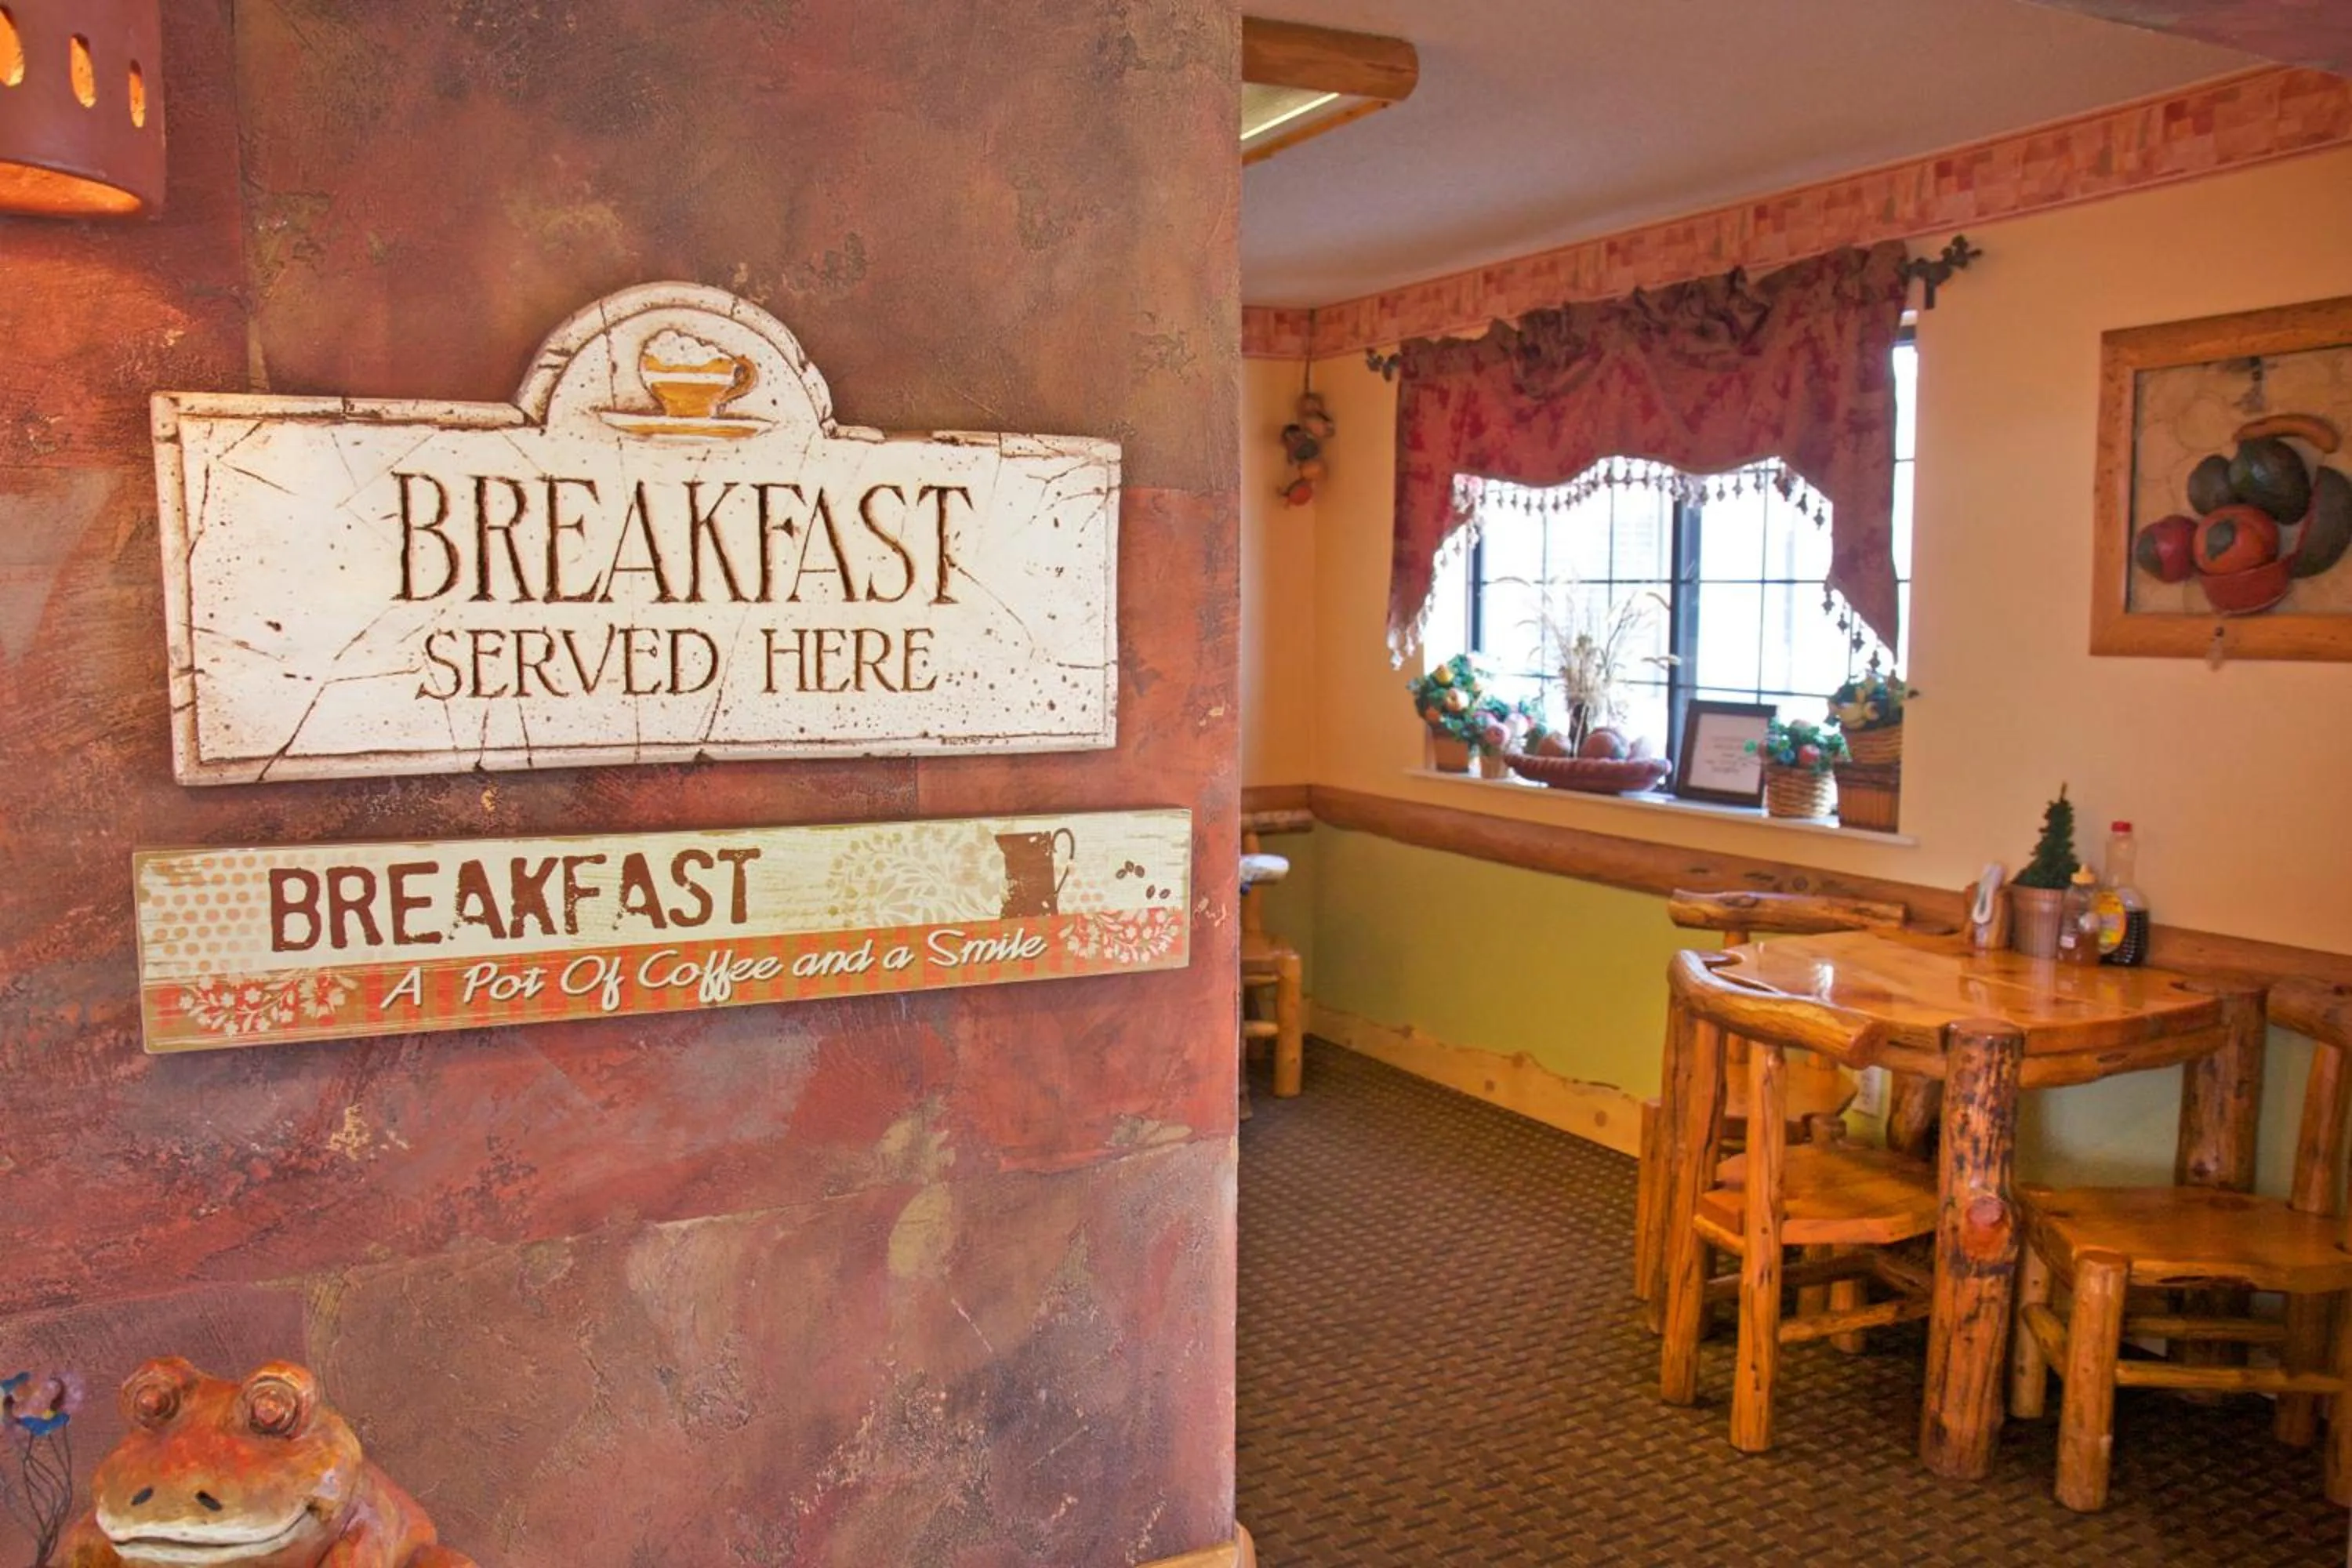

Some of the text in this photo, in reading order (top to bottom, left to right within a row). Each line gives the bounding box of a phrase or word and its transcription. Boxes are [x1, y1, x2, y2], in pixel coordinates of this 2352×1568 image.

[391, 472, 974, 603] BREAKFAST
[416, 625, 938, 700] SERVED HERE
[269, 848, 760, 952] BREAKFAST
[380, 927, 1047, 1011] A Pot Of Coffee and a Smile
